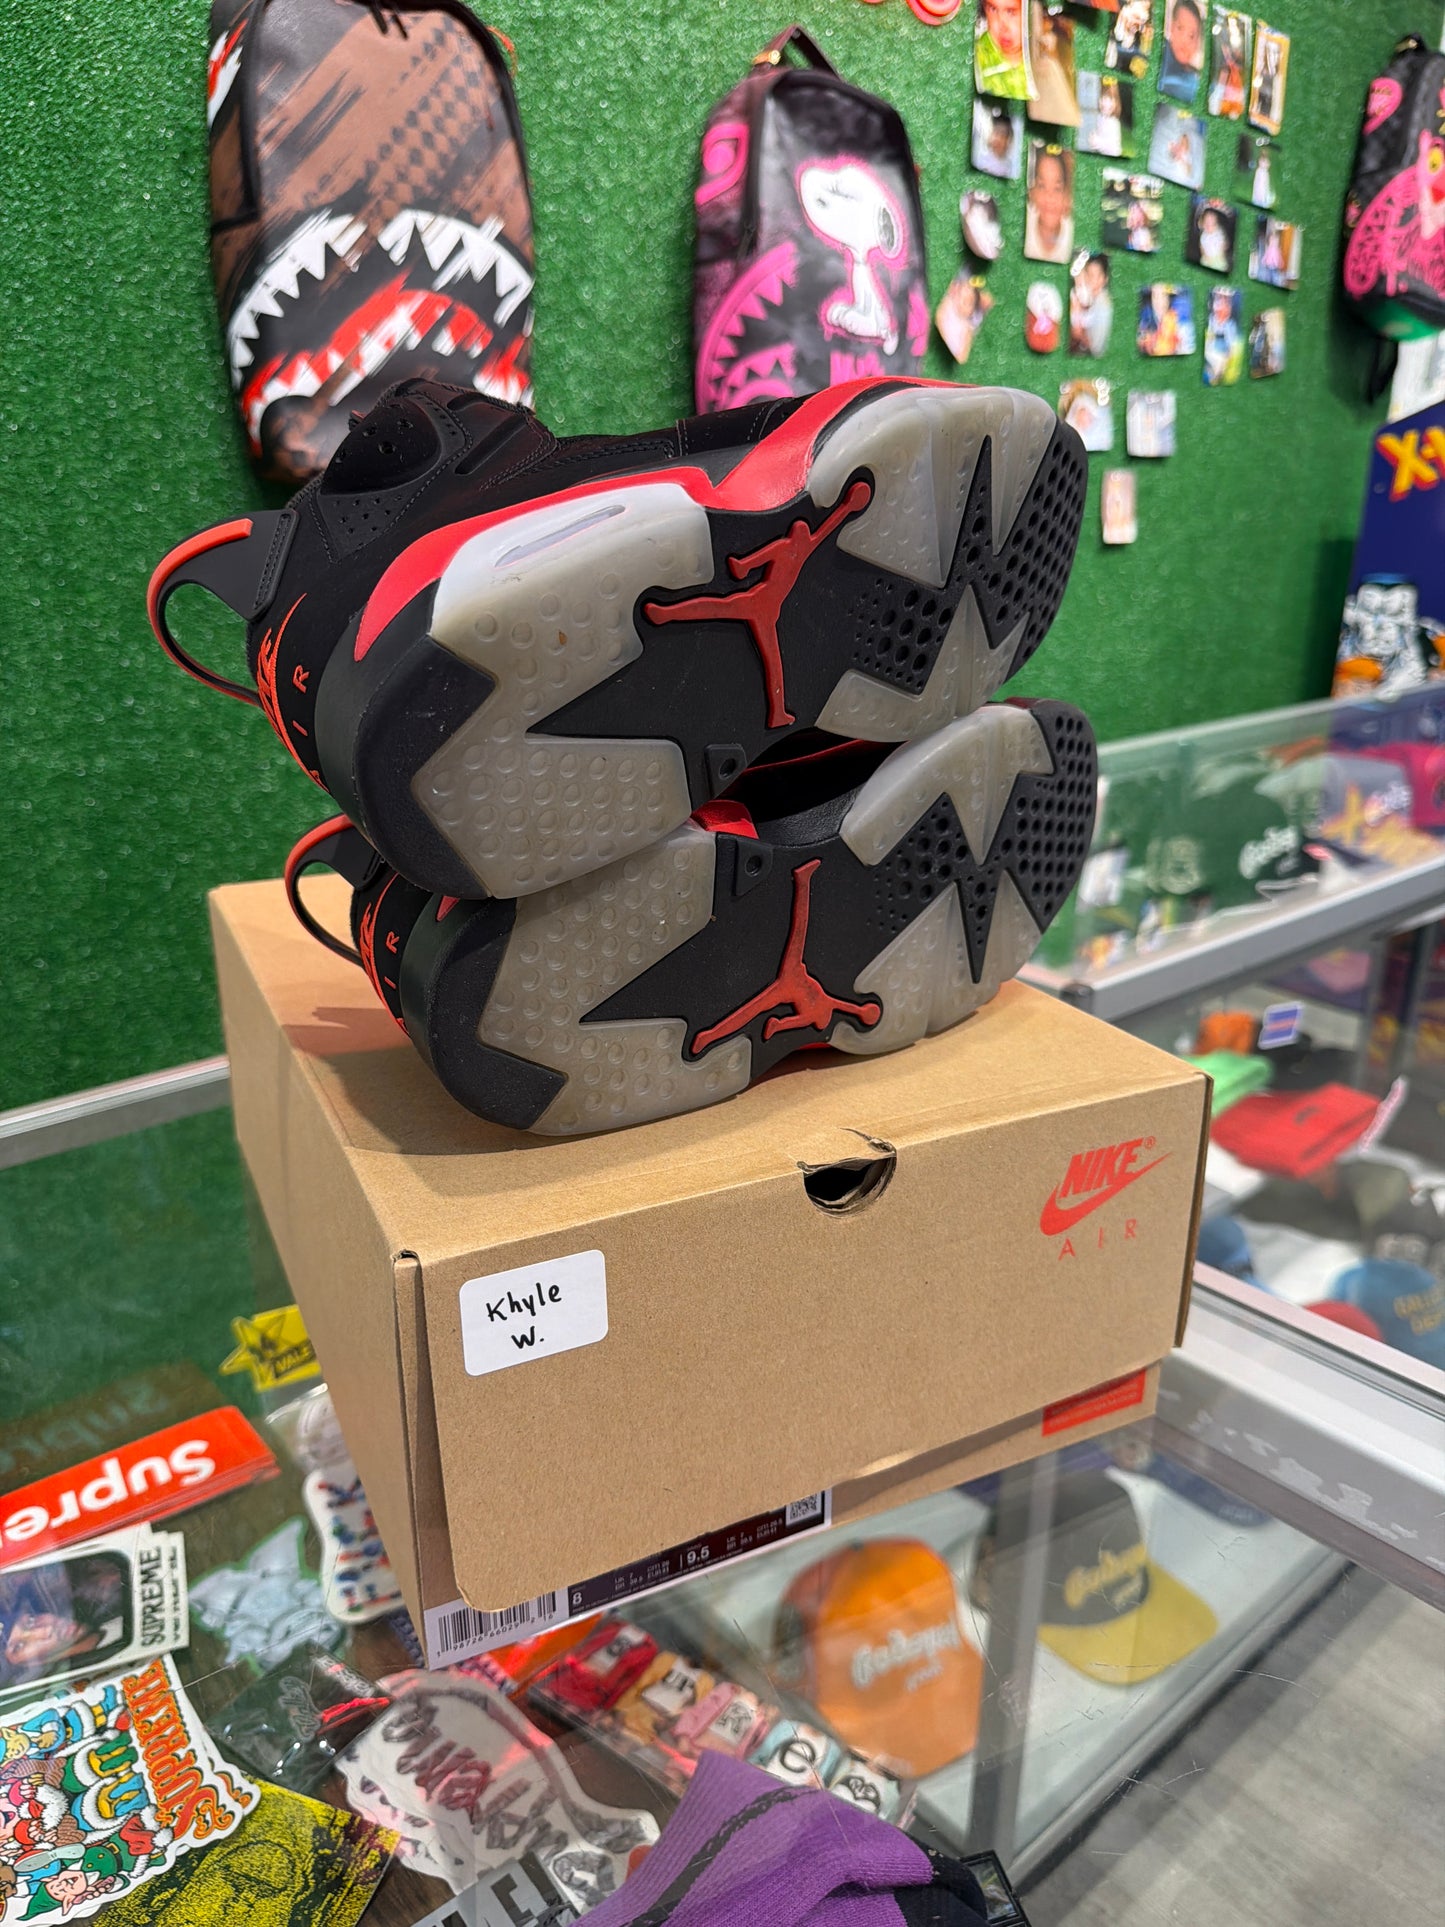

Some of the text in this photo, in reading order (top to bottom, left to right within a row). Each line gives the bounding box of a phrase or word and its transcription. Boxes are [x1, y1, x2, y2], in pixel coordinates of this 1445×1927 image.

[486, 1282, 562, 1322] Khyle
[511, 1325, 544, 1349] W.
[0, 1439, 216, 1549] Supre
[686, 1545, 710, 1565] 9.5
[140, 1546, 165, 1647] SUPREME
[572, 1591, 582, 1606] 8
[121, 1658, 235, 1840] SUPREME
